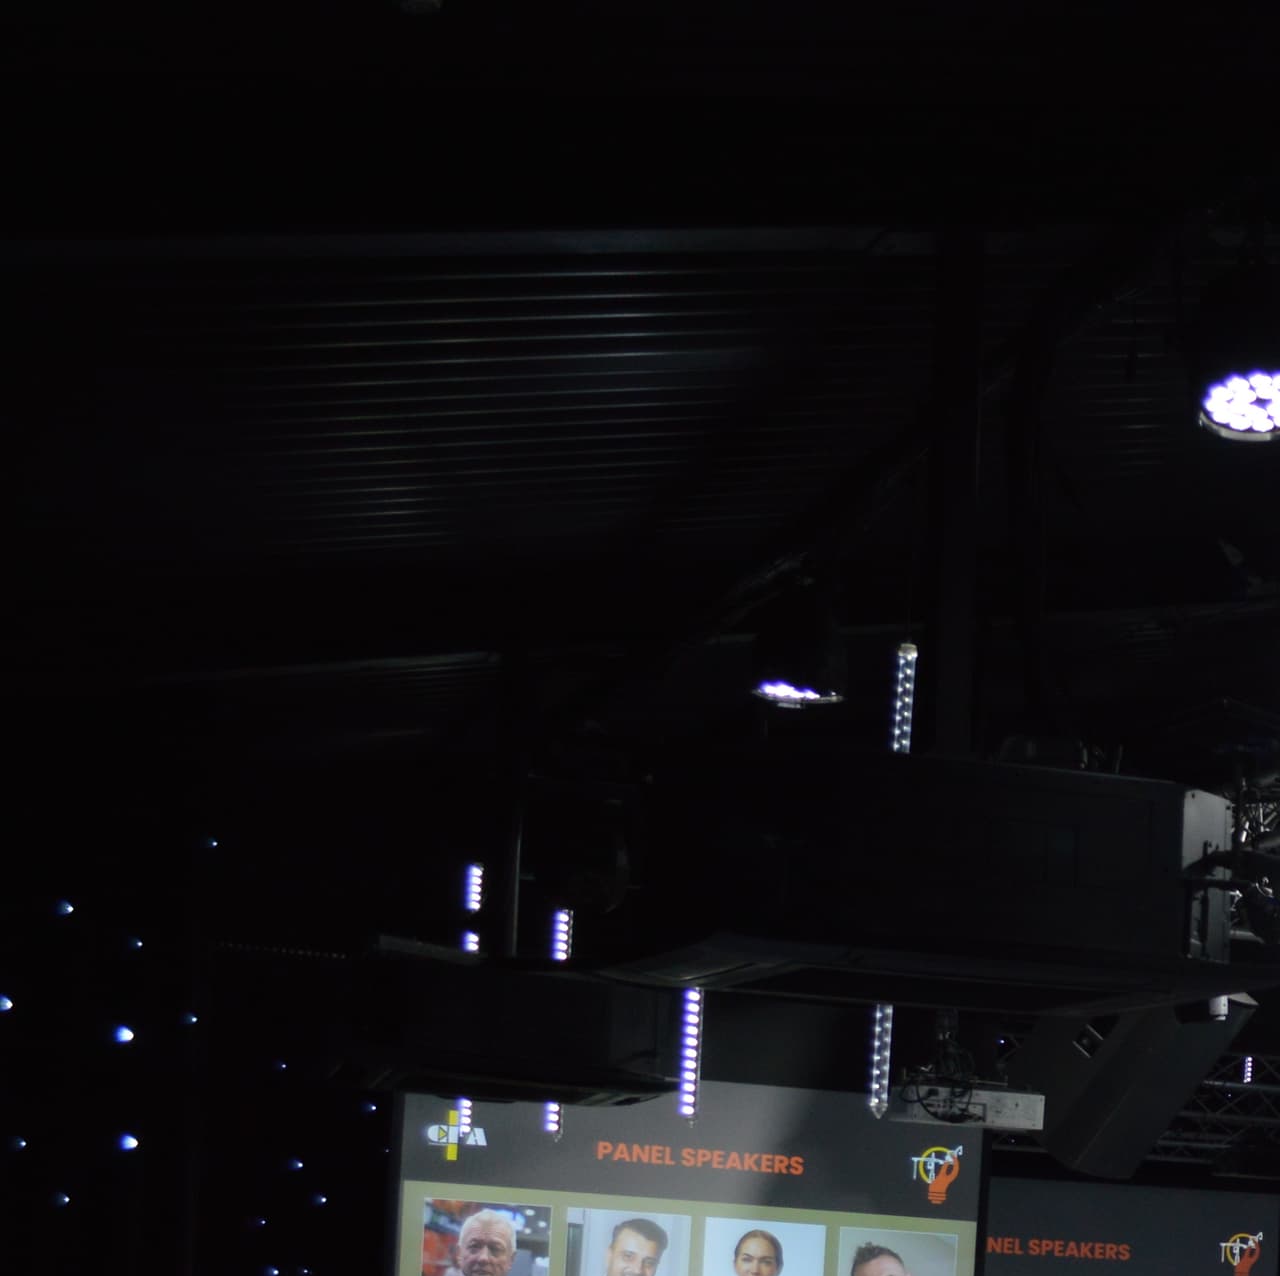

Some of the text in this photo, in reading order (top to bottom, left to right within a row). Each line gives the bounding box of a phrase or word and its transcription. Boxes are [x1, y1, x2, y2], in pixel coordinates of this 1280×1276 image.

[596, 1141, 804, 1175] PANEL SPEAKERS
[987, 1236, 1131, 1260] NEL SPEAKERS
